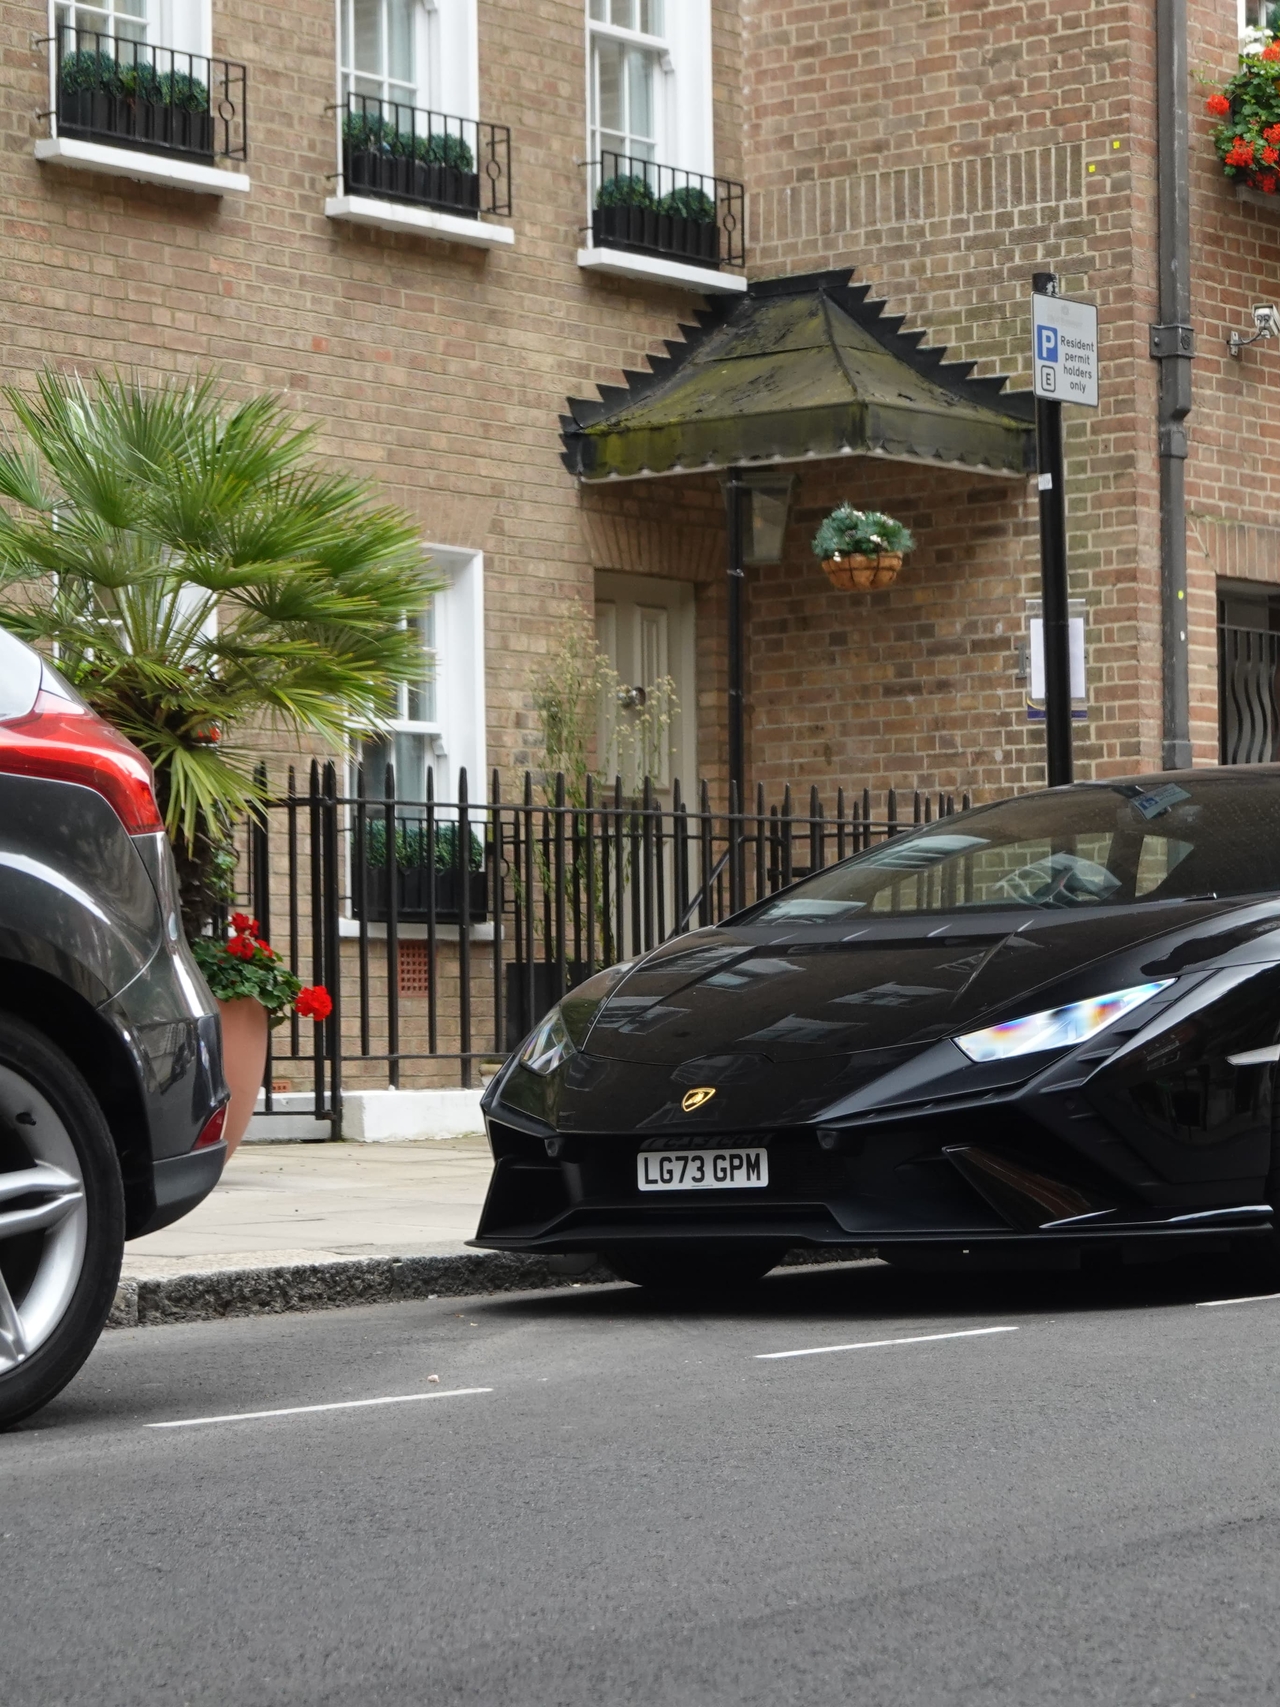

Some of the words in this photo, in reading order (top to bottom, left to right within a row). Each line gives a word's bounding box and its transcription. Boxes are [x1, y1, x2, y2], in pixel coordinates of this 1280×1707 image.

[1042, 329, 1055, 358] P
[1060, 335, 1094, 352] Resident
[1065, 352, 1090, 365] permit
[1063, 363, 1092, 379] holders
[1046, 373, 1052, 386] E
[1070, 380, 1086, 394] only
[644, 1155, 705, 1184] LG73
[712, 1153, 761, 1182] GPM
